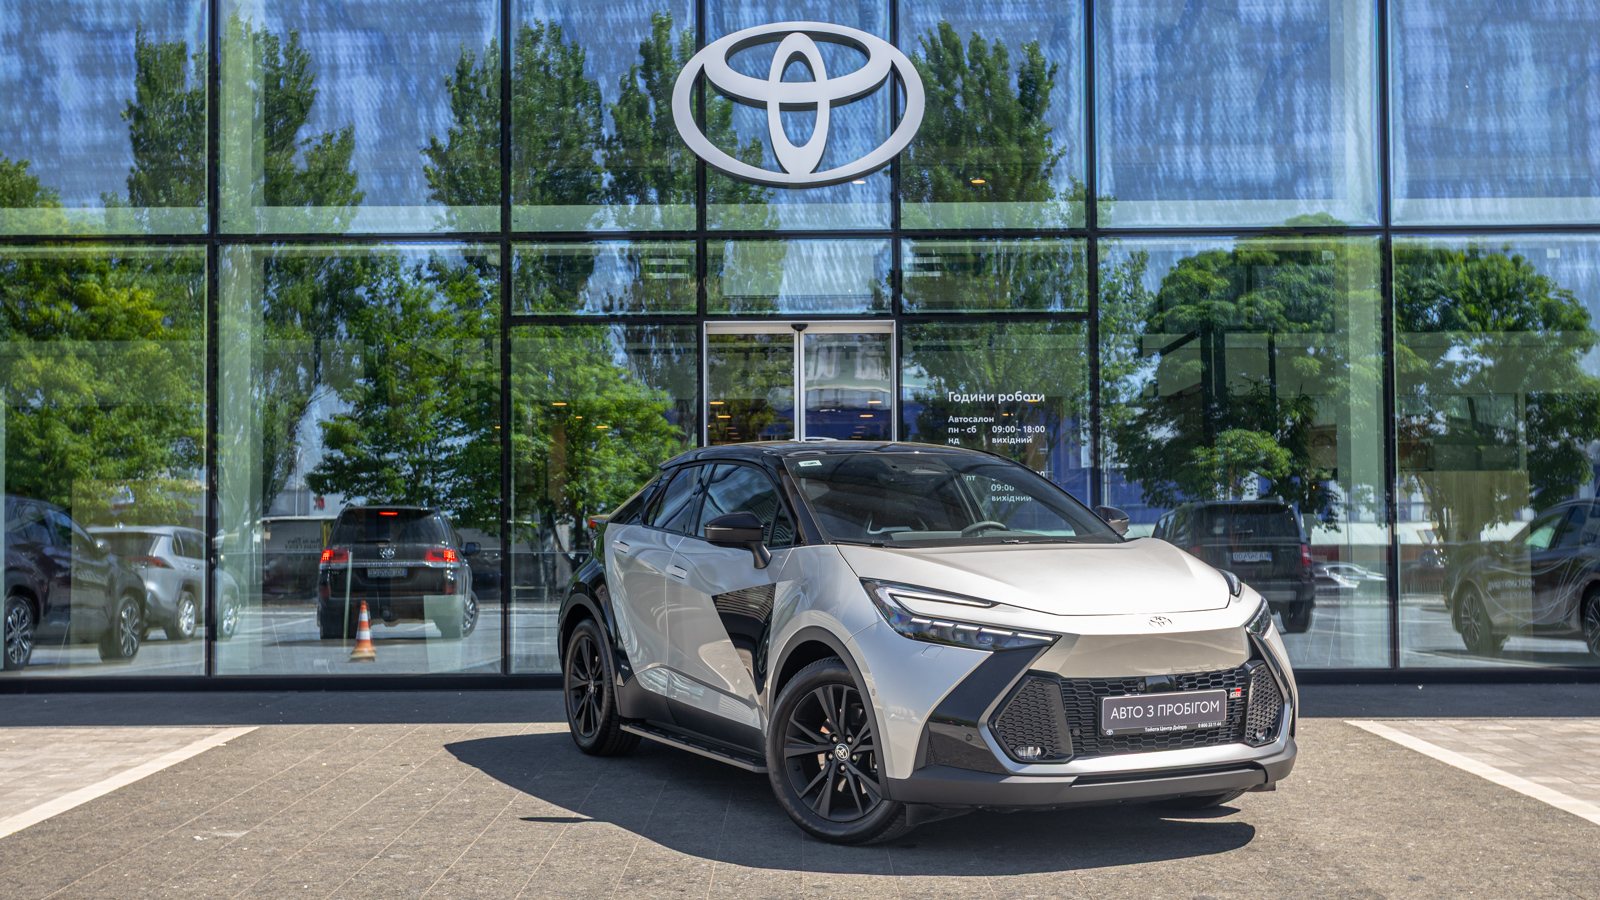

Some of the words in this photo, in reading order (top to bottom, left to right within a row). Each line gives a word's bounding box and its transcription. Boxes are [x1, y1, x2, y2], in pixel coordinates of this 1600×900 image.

[948, 391, 995, 404] Години
[998, 390, 1045, 404] роботи
[948, 415, 995, 423] Автосалон
[966, 425, 977, 434] сб
[992, 425, 1015, 433] 09:00
[1023, 425, 1046, 433] 18:00
[991, 436, 1033, 445] вихідний
[1110, 705, 1144, 720] АВТО
[1157, 700, 1220, 717] ПРОБІГОМ
